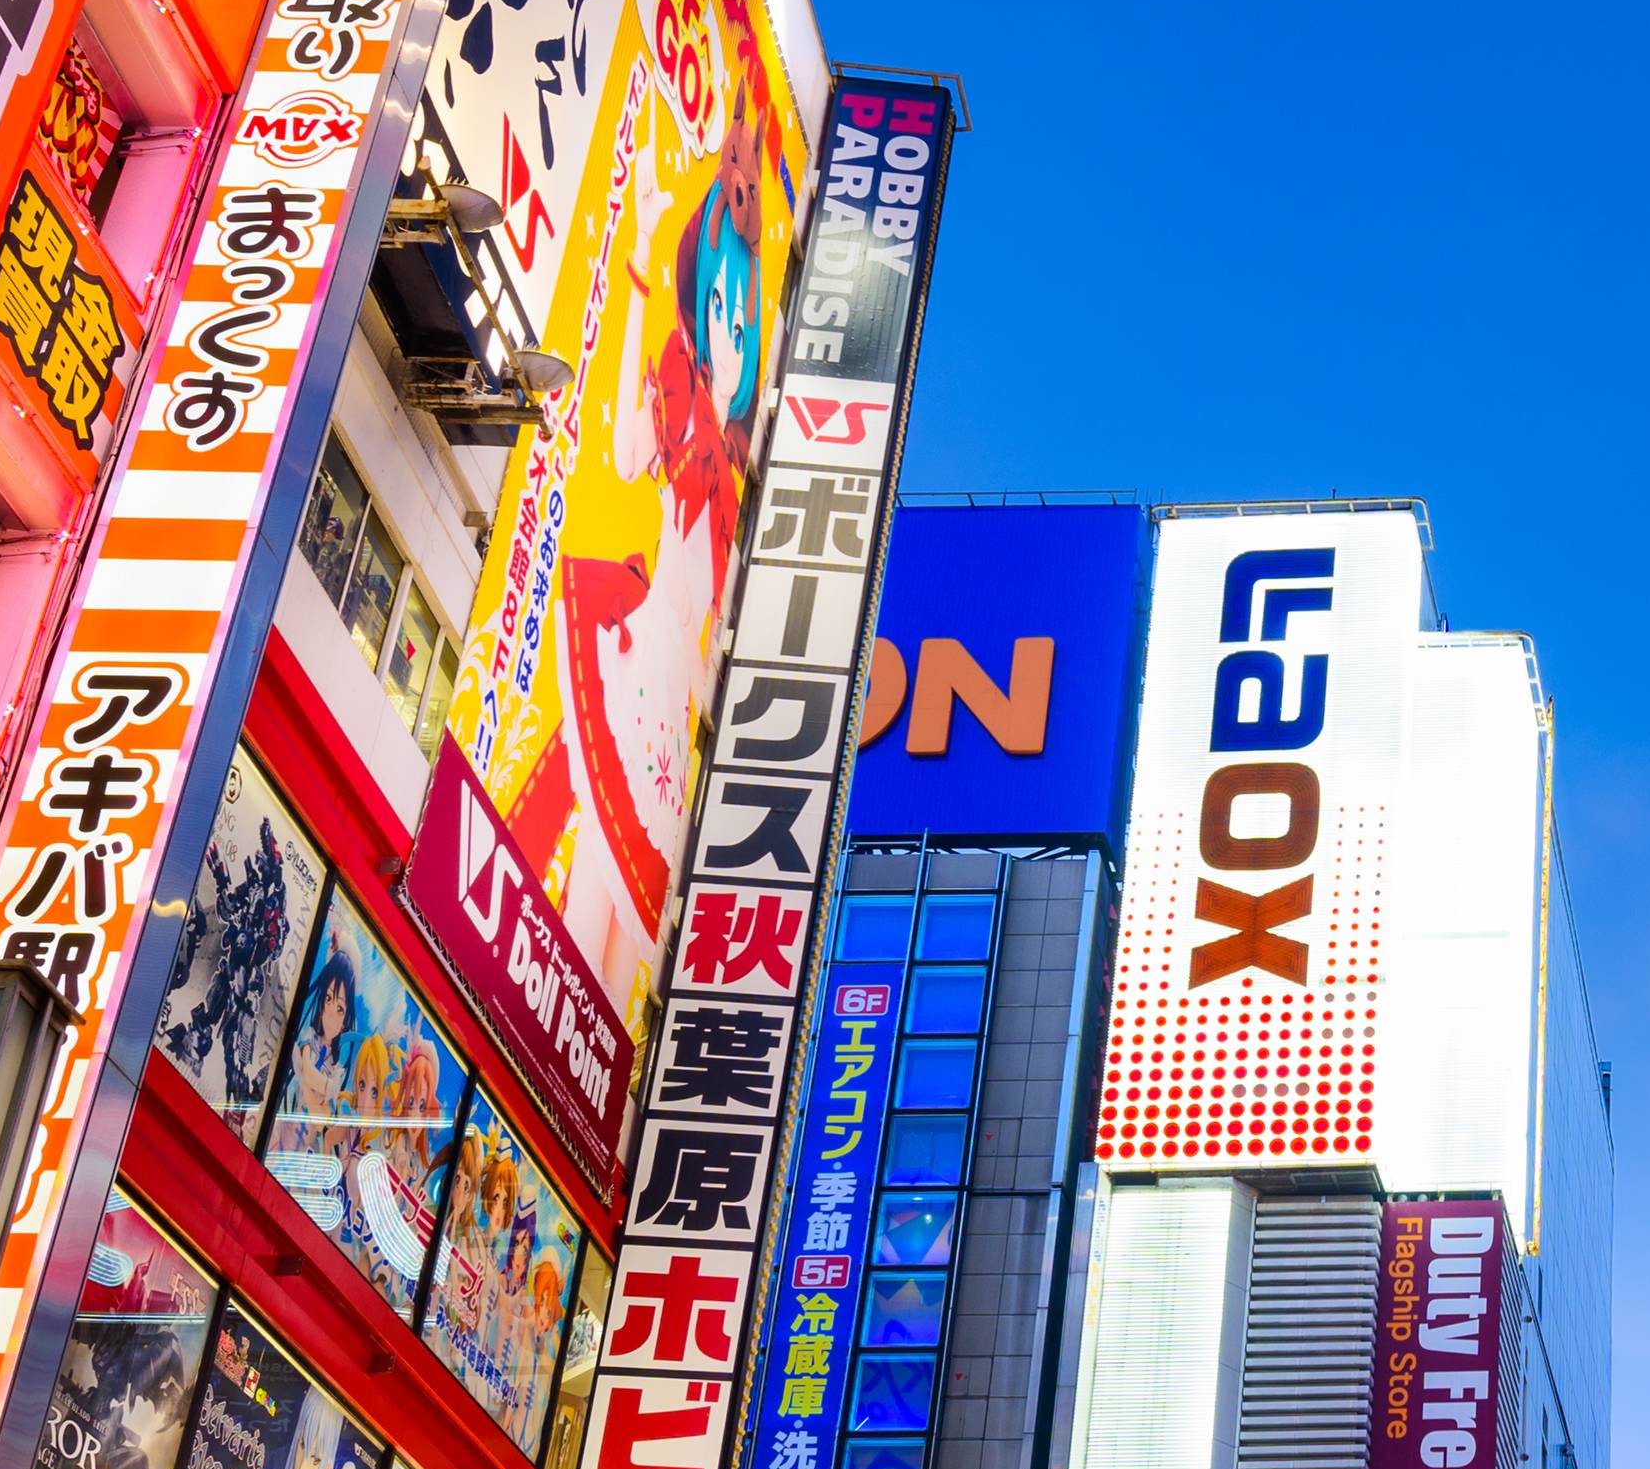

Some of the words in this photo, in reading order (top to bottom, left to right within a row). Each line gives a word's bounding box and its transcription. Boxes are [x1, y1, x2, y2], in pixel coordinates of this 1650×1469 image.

[793, 93, 877, 367] PARADISE
[870, 100, 937, 278] HOBBY
[1384, 1218, 1424, 1341] Flagship
[1420, 1216, 1495, 1356] Duty
[1386, 1352, 1418, 1440] Store
